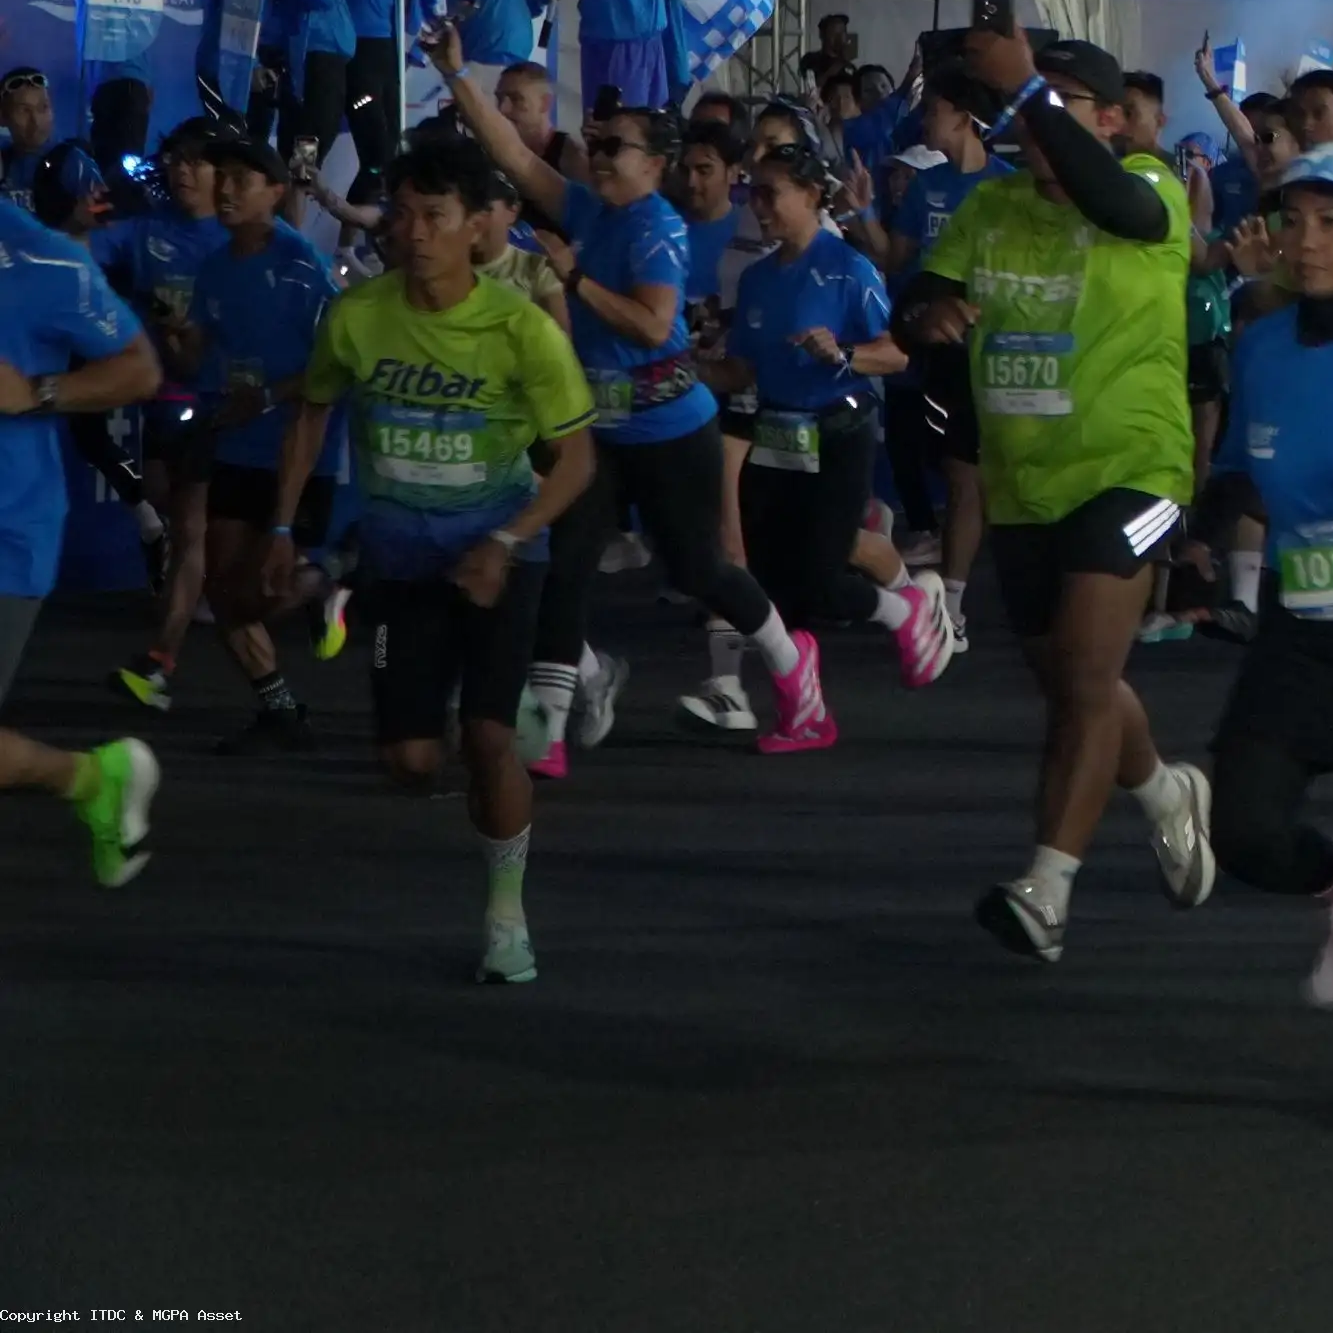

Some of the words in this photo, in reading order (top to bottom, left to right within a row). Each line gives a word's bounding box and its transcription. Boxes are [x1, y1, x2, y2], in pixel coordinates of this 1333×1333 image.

[366, 358, 486, 398] Fitbar
[987, 356, 1059, 385] 15670
[379, 427, 473, 461] 15469
